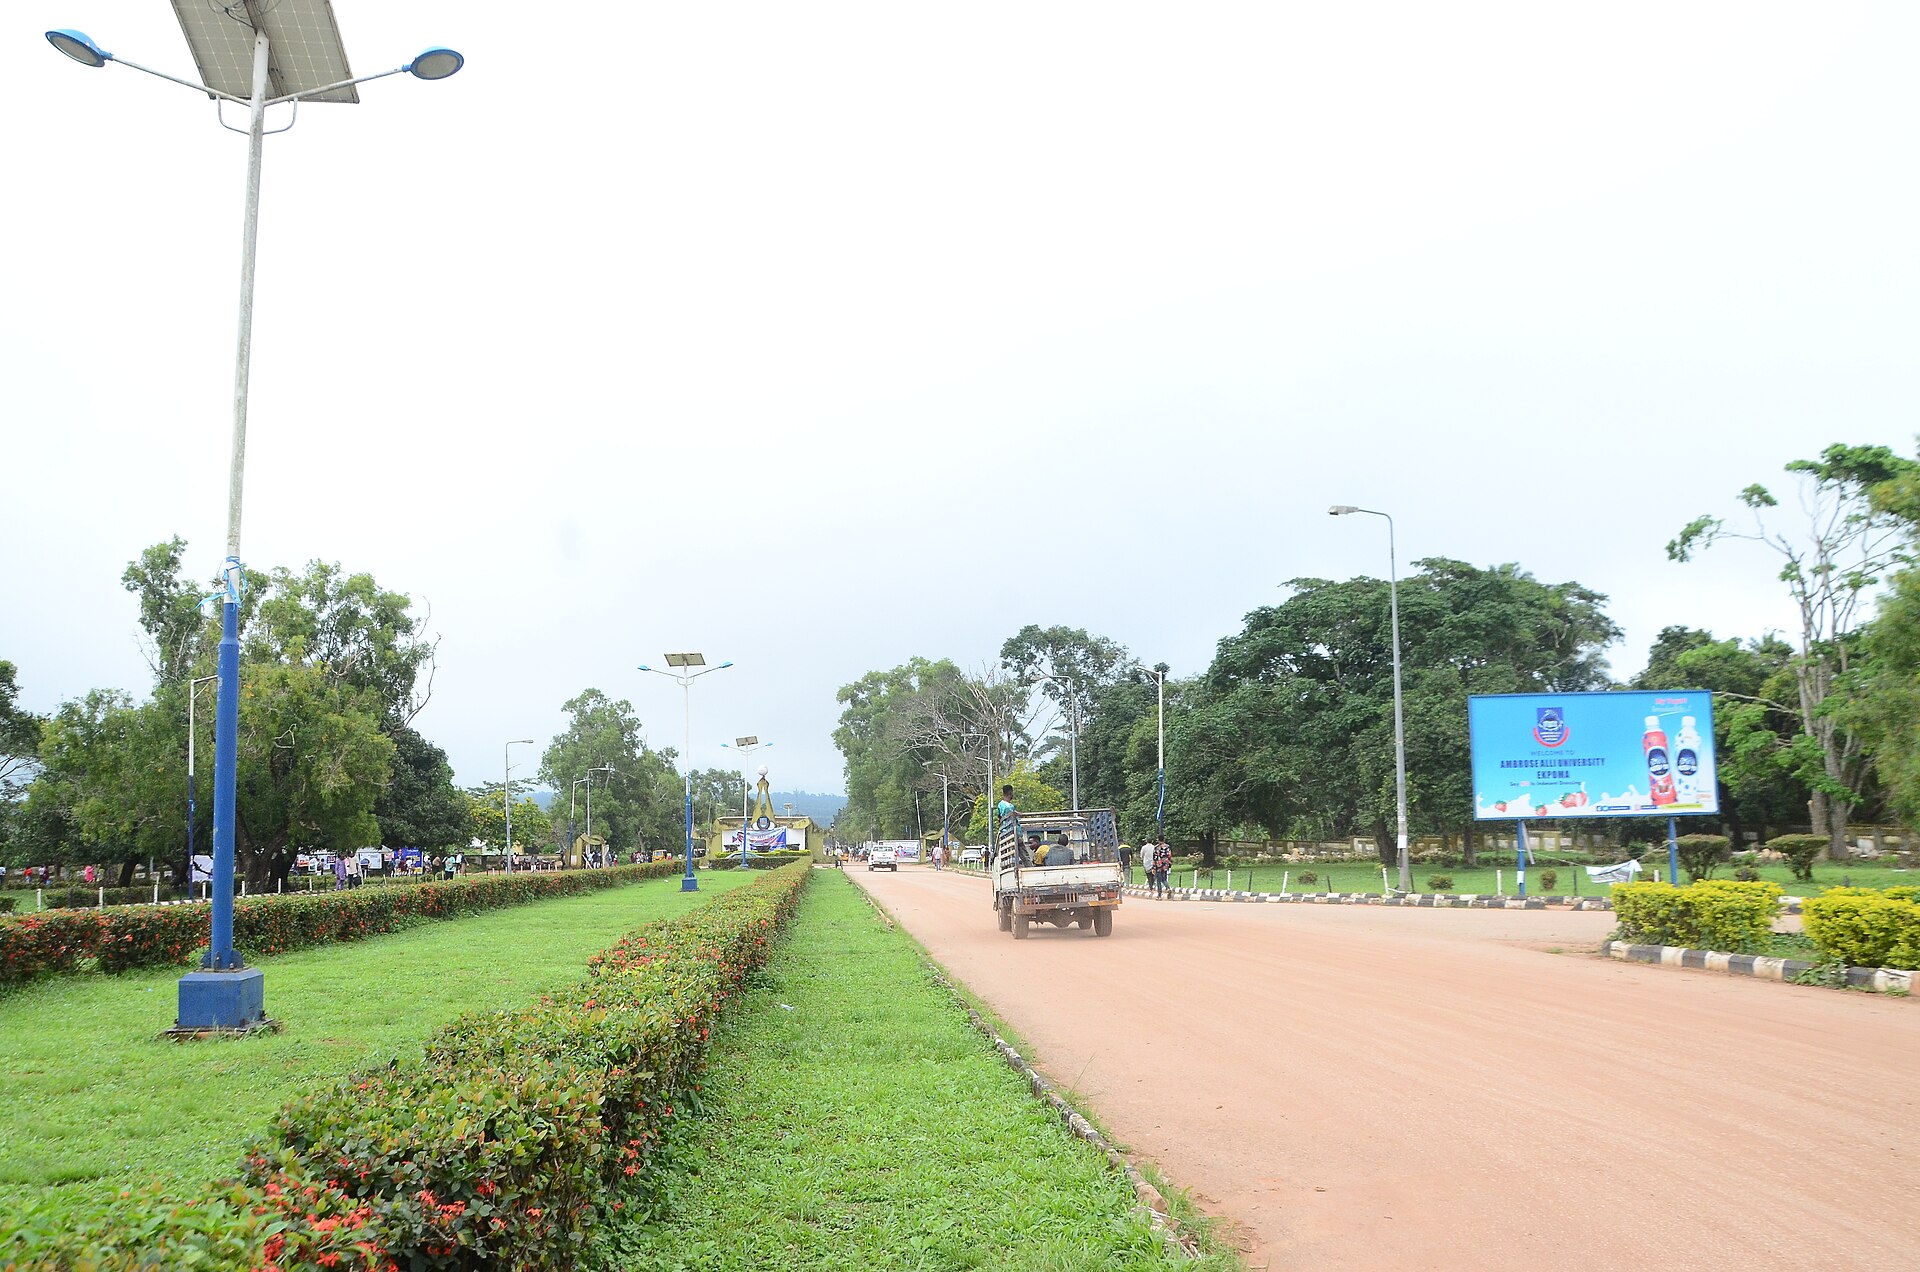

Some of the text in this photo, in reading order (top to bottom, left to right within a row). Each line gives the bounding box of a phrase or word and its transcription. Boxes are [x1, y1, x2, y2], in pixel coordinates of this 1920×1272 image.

[1501, 758, 1605, 768] AMBROSE ALLI UNIVERSITY
[1537, 771, 1569, 779] EKPOMA
